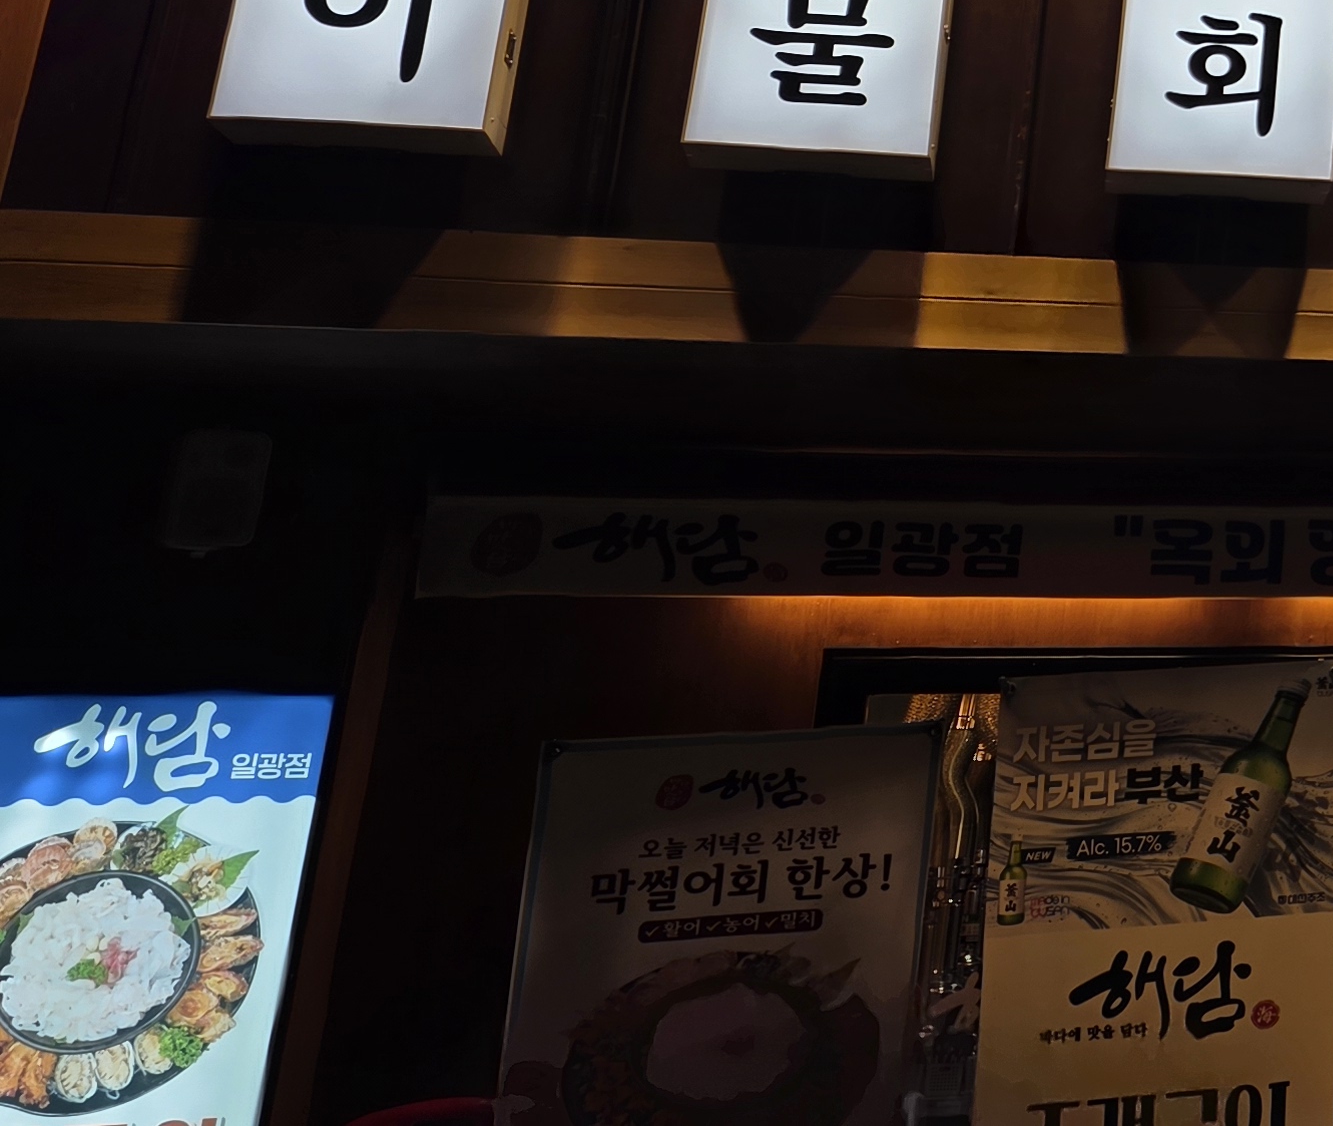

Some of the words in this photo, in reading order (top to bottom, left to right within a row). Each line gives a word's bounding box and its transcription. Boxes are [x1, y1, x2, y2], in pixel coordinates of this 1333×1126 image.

[553, 511, 759, 585] 해담
[821, 520, 1024, 578] 일광점
[34, 701, 231, 792] 해담
[230, 753, 313, 780] 일광점
[1013, 719, 1157, 764] 자존심을
[699, 768, 808, 809] 해담
[1010, 769, 1119, 812] 지켜라
[1125, 763, 1203, 804] 부산
[639, 839, 686, 859] 오늘
[694, 832, 764, 856] 저녁은
[772, 826, 840, 852] 신선한
[1025, 850, 1052, 862] NEW
[1076, 837, 1109, 856] Alc.
[1114, 834, 1162, 854] 15.7%
[591, 860, 768, 914] 막썰어회
[786, 853, 892, 900] 한상!
[663, 919, 700, 938] 활어
[723, 914, 760, 933] 농어
[780, 911, 815, 929] 밀치
[1069, 941, 1251, 1039] 해담
[1040, 1027, 1081, 1043] 바다에
[1087, 1025, 1114, 1041] 맛을
[1121, 1023, 1147, 1038] 담다
